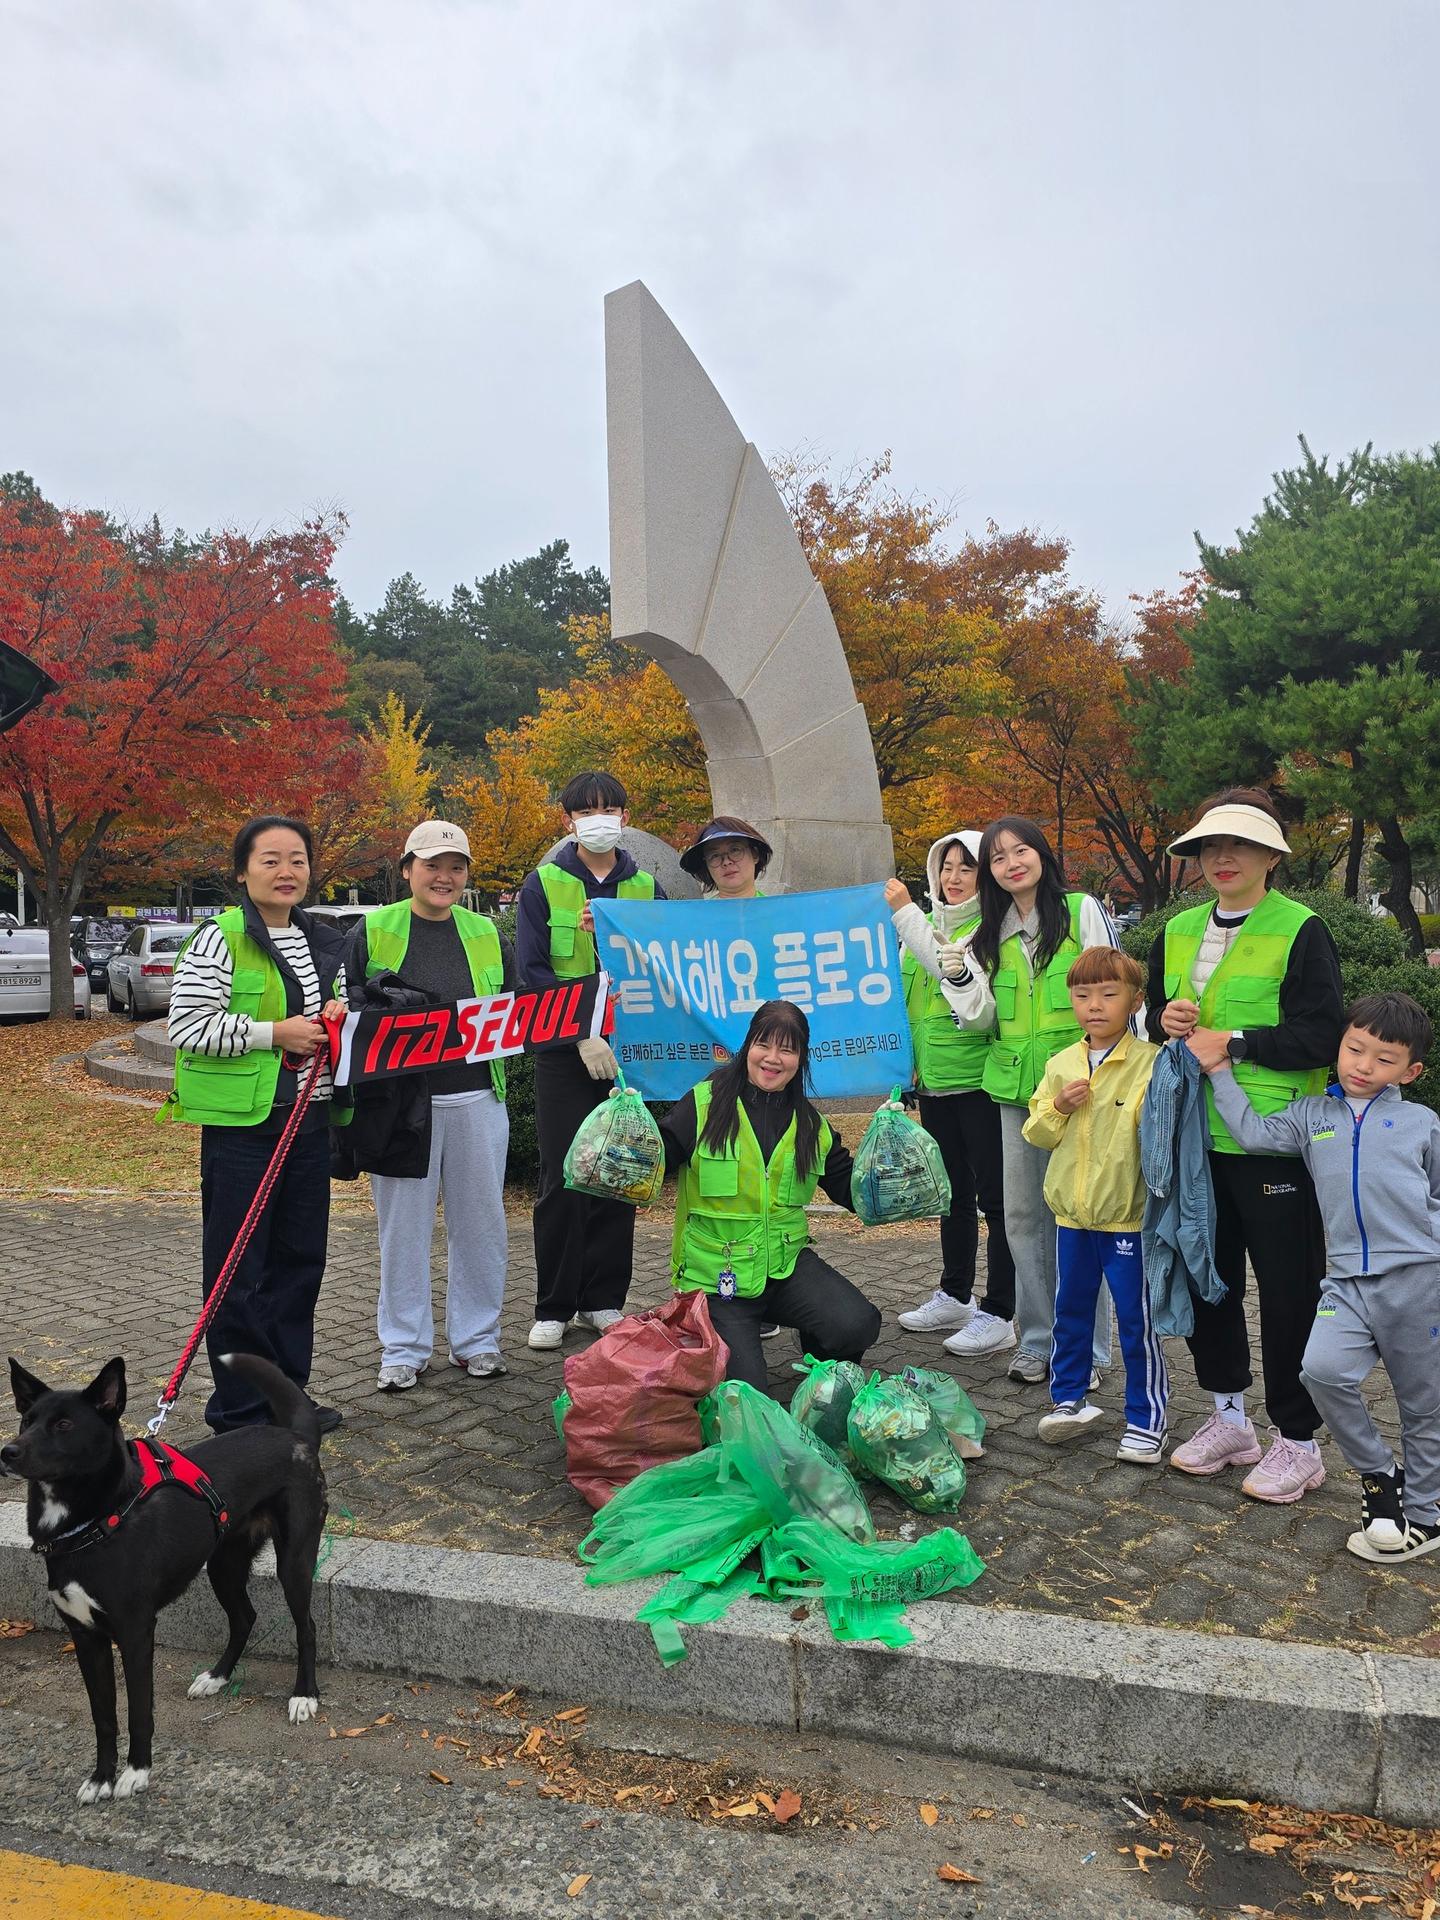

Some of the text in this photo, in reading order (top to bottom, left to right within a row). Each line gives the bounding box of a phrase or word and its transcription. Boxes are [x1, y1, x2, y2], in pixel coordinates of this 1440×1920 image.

[442, 831, 454, 839] NY
[609, 922, 892, 1019] 같이해요 플로깅
[621, 1033, 903, 1063] 함께하고 싶은 분은 ng으로 문의주세요!
